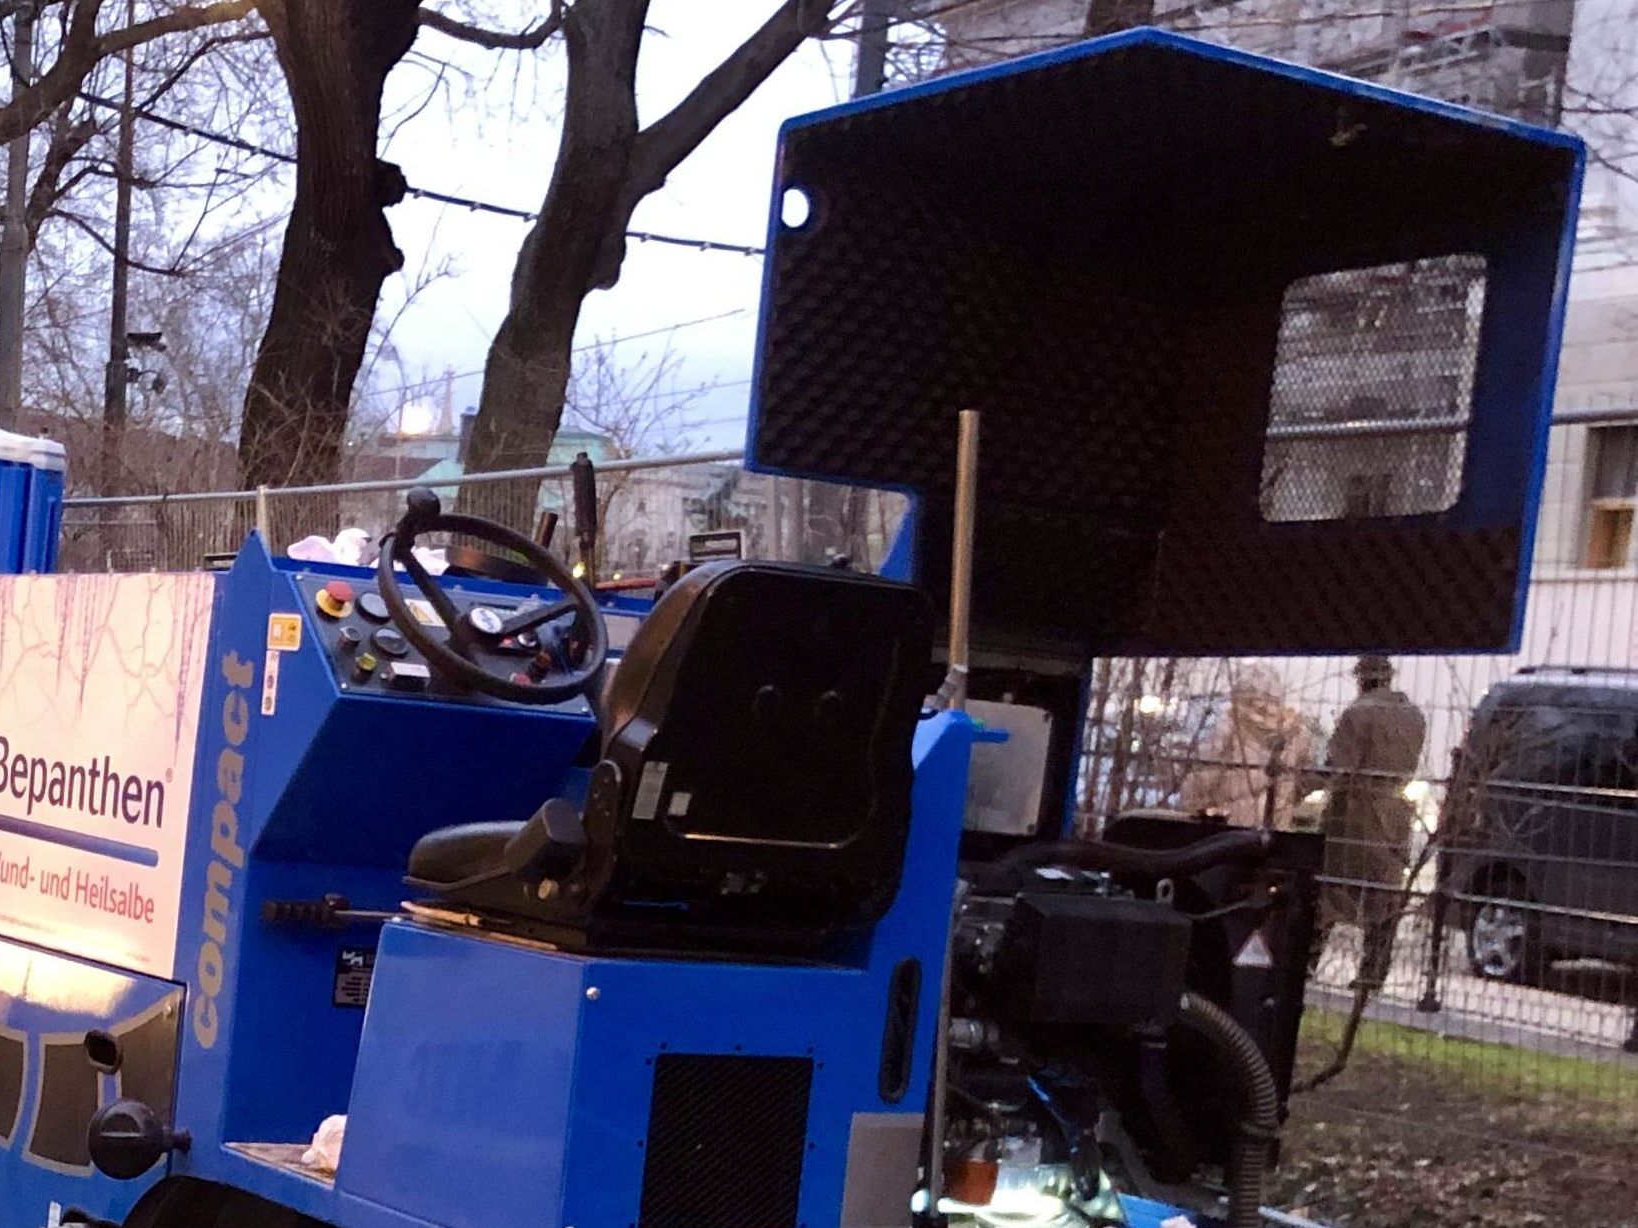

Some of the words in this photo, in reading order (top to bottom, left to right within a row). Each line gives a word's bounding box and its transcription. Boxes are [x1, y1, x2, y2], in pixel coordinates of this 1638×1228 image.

[40, 866, 71, 900] und
[75, 870, 155, 923] Heilsalbe
[193, 649, 255, 1050] compact
